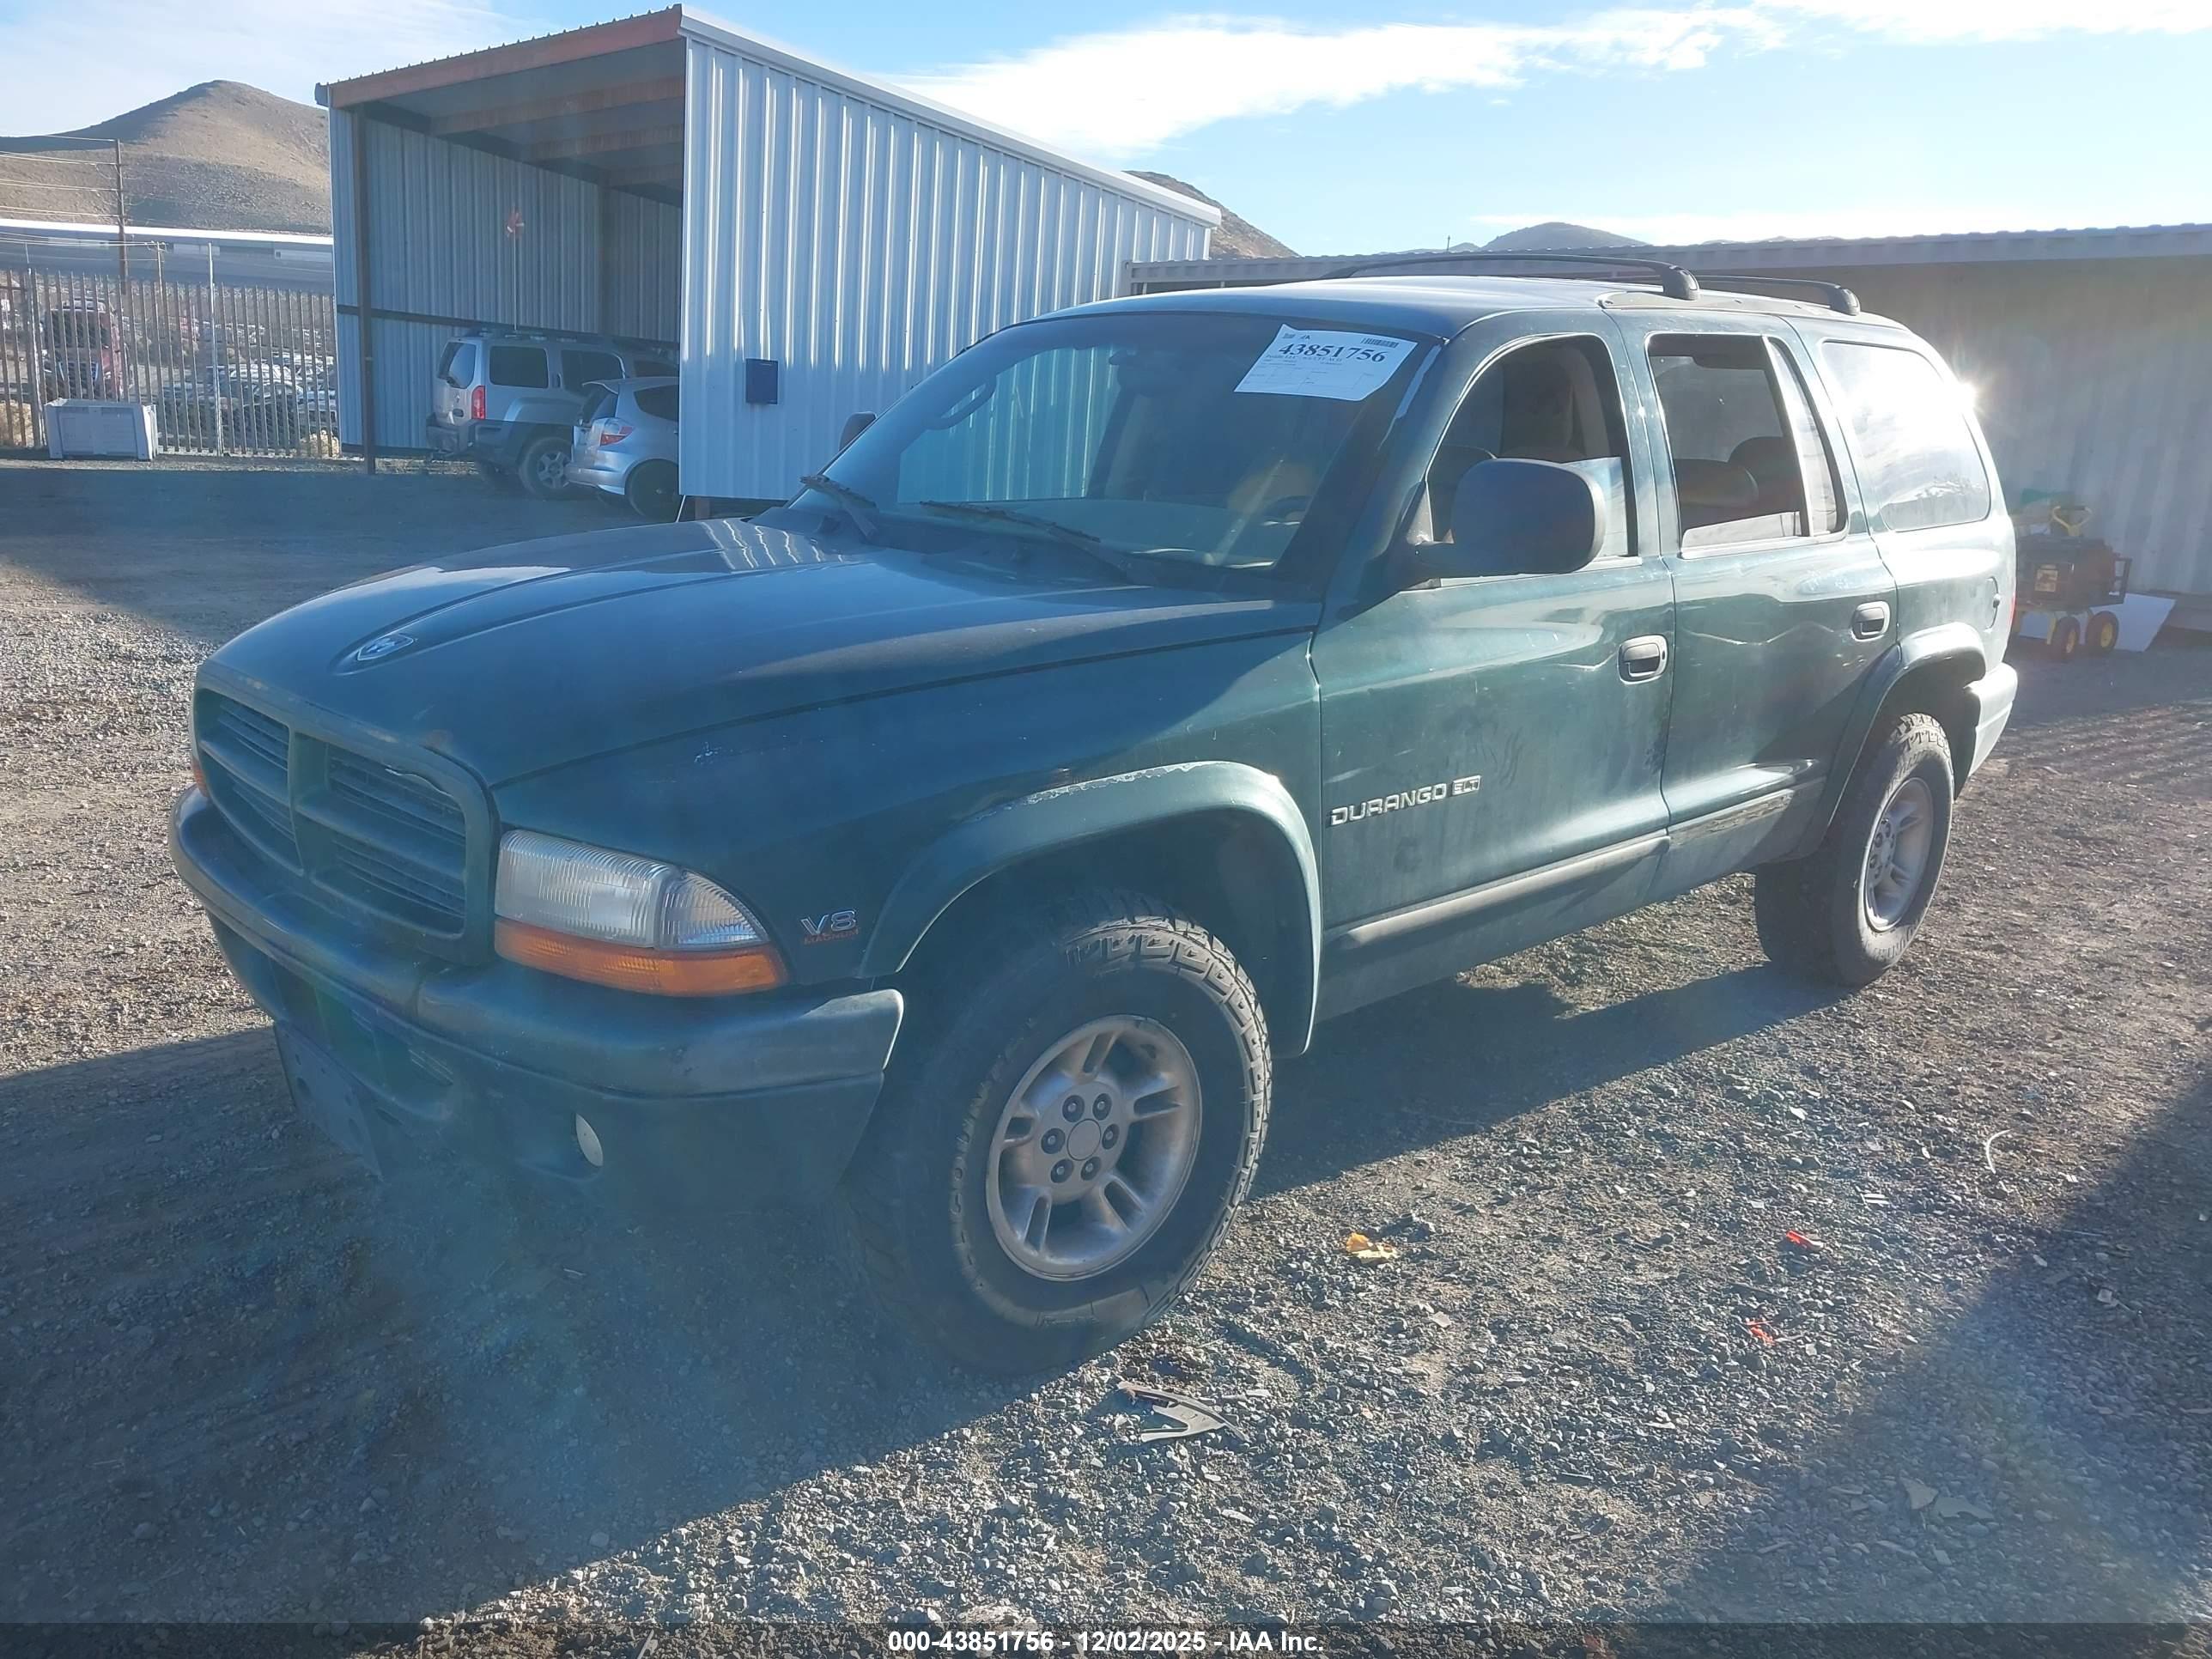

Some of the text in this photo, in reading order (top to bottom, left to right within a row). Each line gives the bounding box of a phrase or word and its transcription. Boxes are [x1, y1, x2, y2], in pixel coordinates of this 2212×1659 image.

[1278, 343, 1388, 362] 43851756
[1330, 782, 1447, 826] DURANGO
[800, 910, 857, 936] V8
